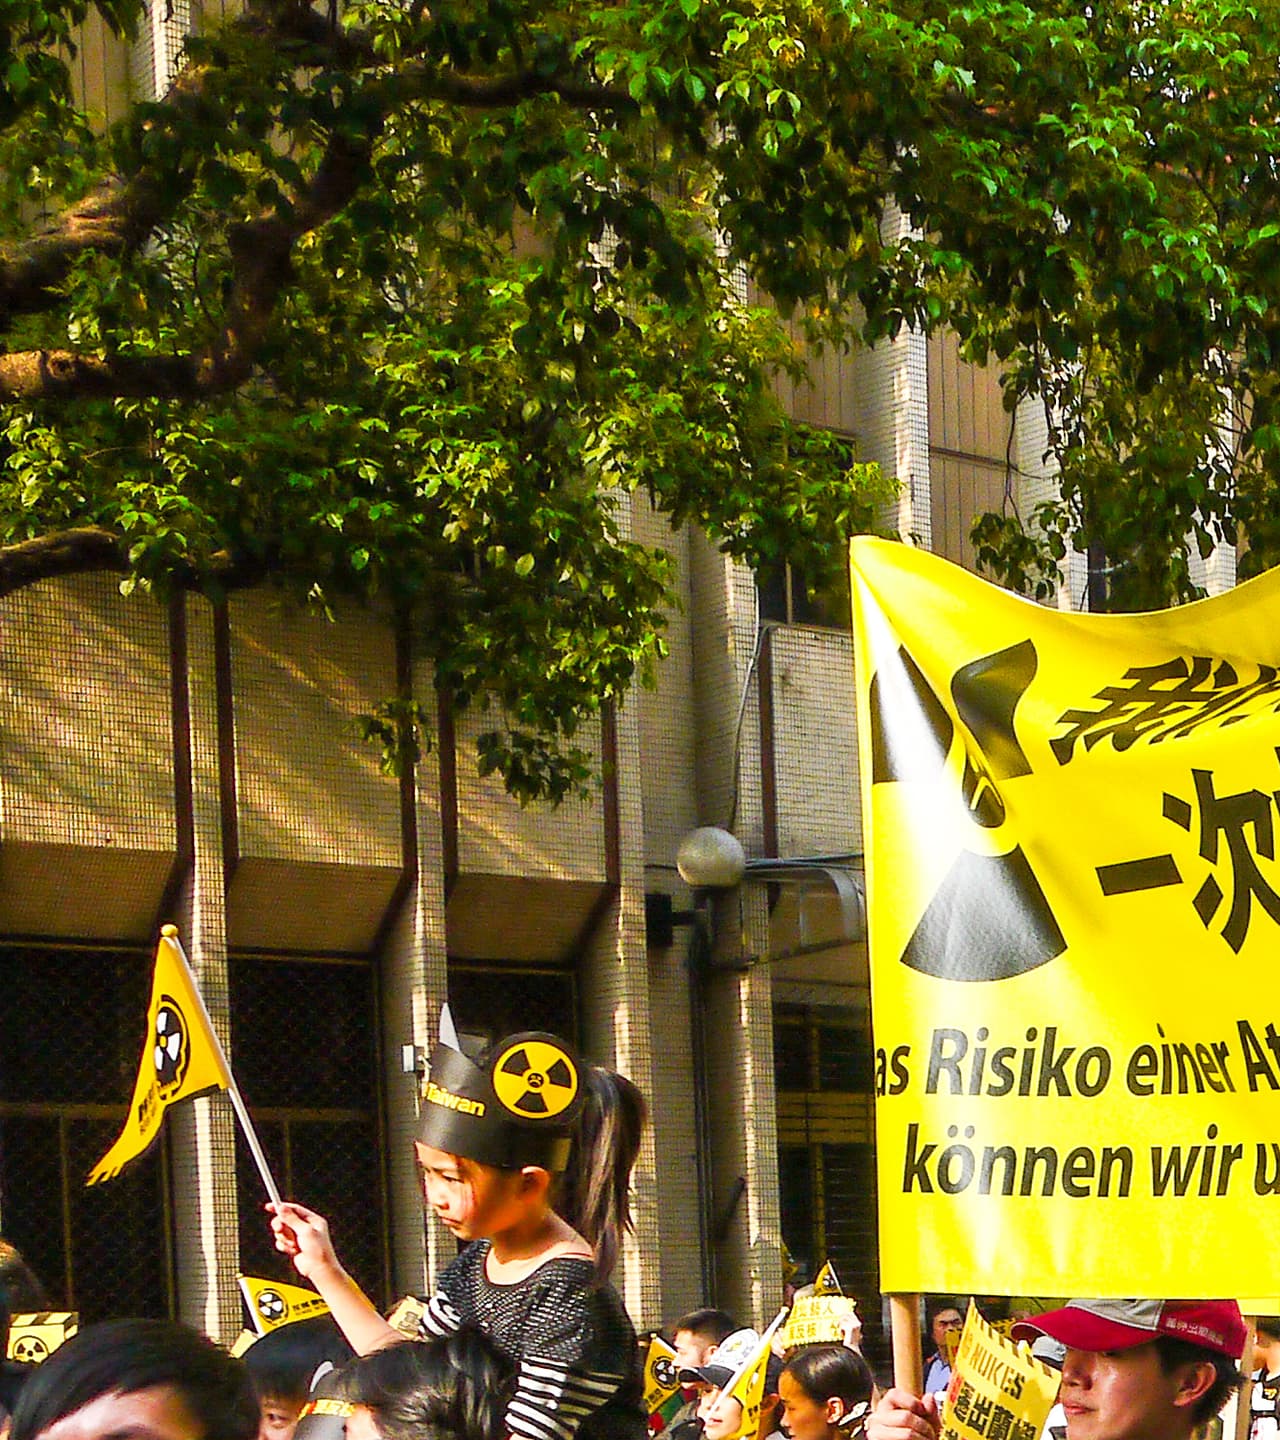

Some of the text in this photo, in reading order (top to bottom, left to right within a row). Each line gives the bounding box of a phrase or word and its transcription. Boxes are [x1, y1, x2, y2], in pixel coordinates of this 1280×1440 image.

[875, 1043, 911, 1098] as
[925, 1026, 1111, 1098] Risiko
[1126, 1022, 1237, 1098] einer
[902, 1123, 1133, 1198] können
[1151, 1123, 1243, 1198] wir
